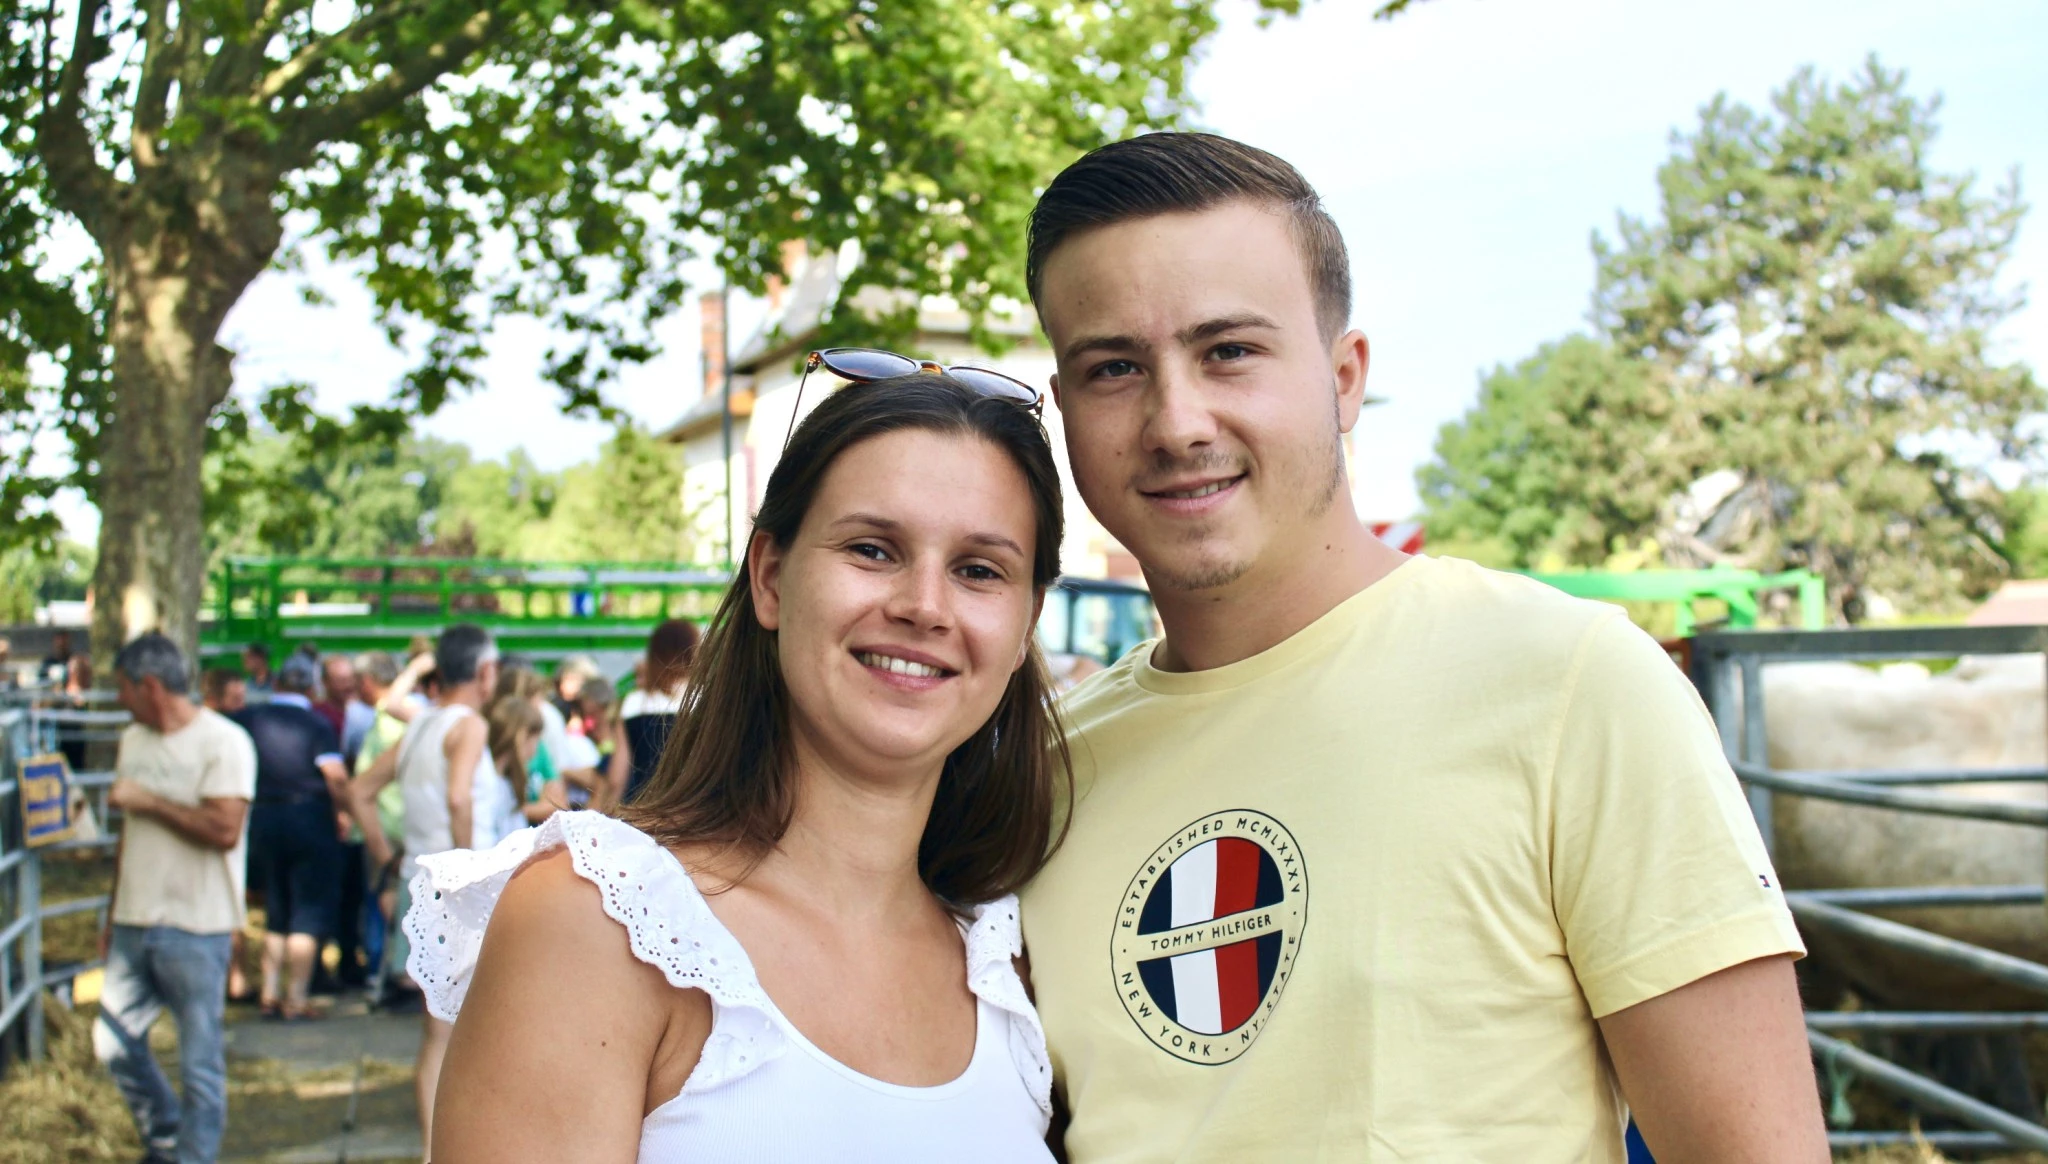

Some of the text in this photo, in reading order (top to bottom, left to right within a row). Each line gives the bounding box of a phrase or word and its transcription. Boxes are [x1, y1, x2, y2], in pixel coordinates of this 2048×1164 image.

[1122, 817, 1300, 928] ESTABLISHED MCMLXXXV
[1151, 914, 1272, 951] TOMMY HILFIGER
[1121, 973, 1152, 1018] NEW
[1159, 1025, 1211, 1056] YORK
